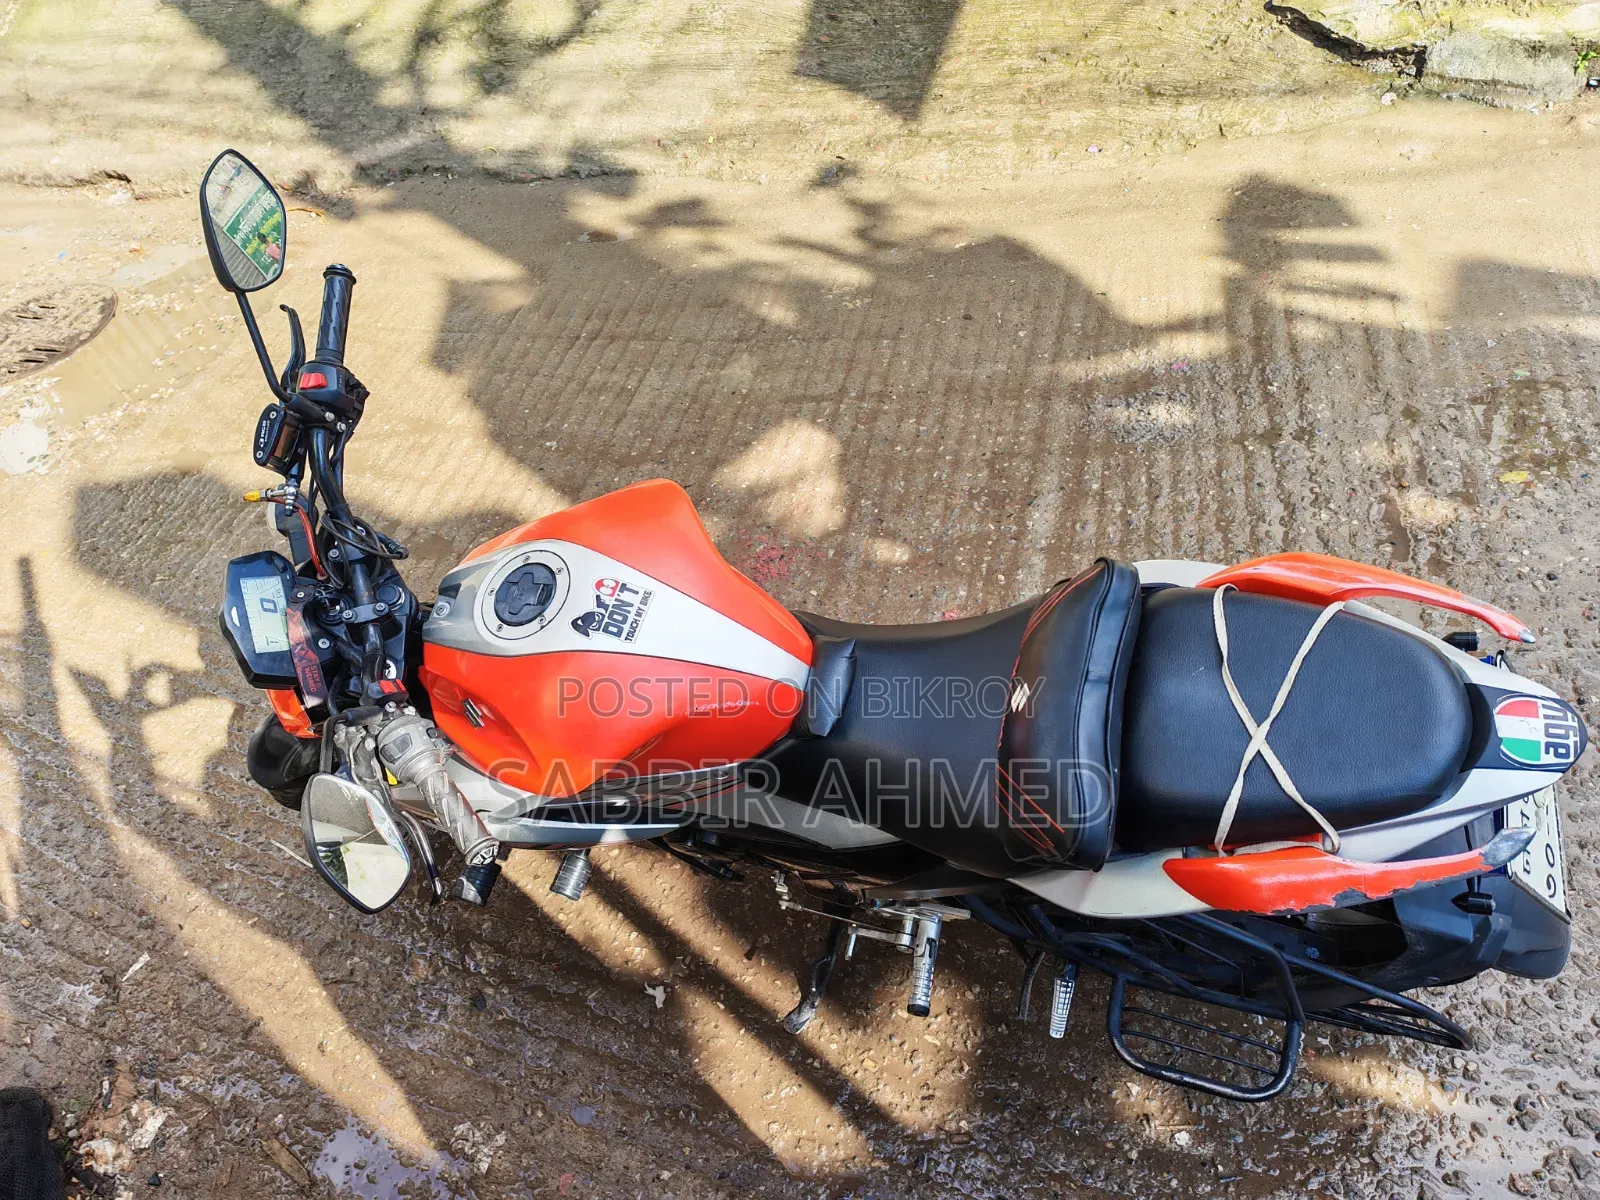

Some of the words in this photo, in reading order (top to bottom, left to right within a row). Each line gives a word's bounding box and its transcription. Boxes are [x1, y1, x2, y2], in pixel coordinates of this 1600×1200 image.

[639, 590, 652, 606] BIKE
[634, 606, 645, 618] MY
[624, 618, 641, 641] TOUCH
